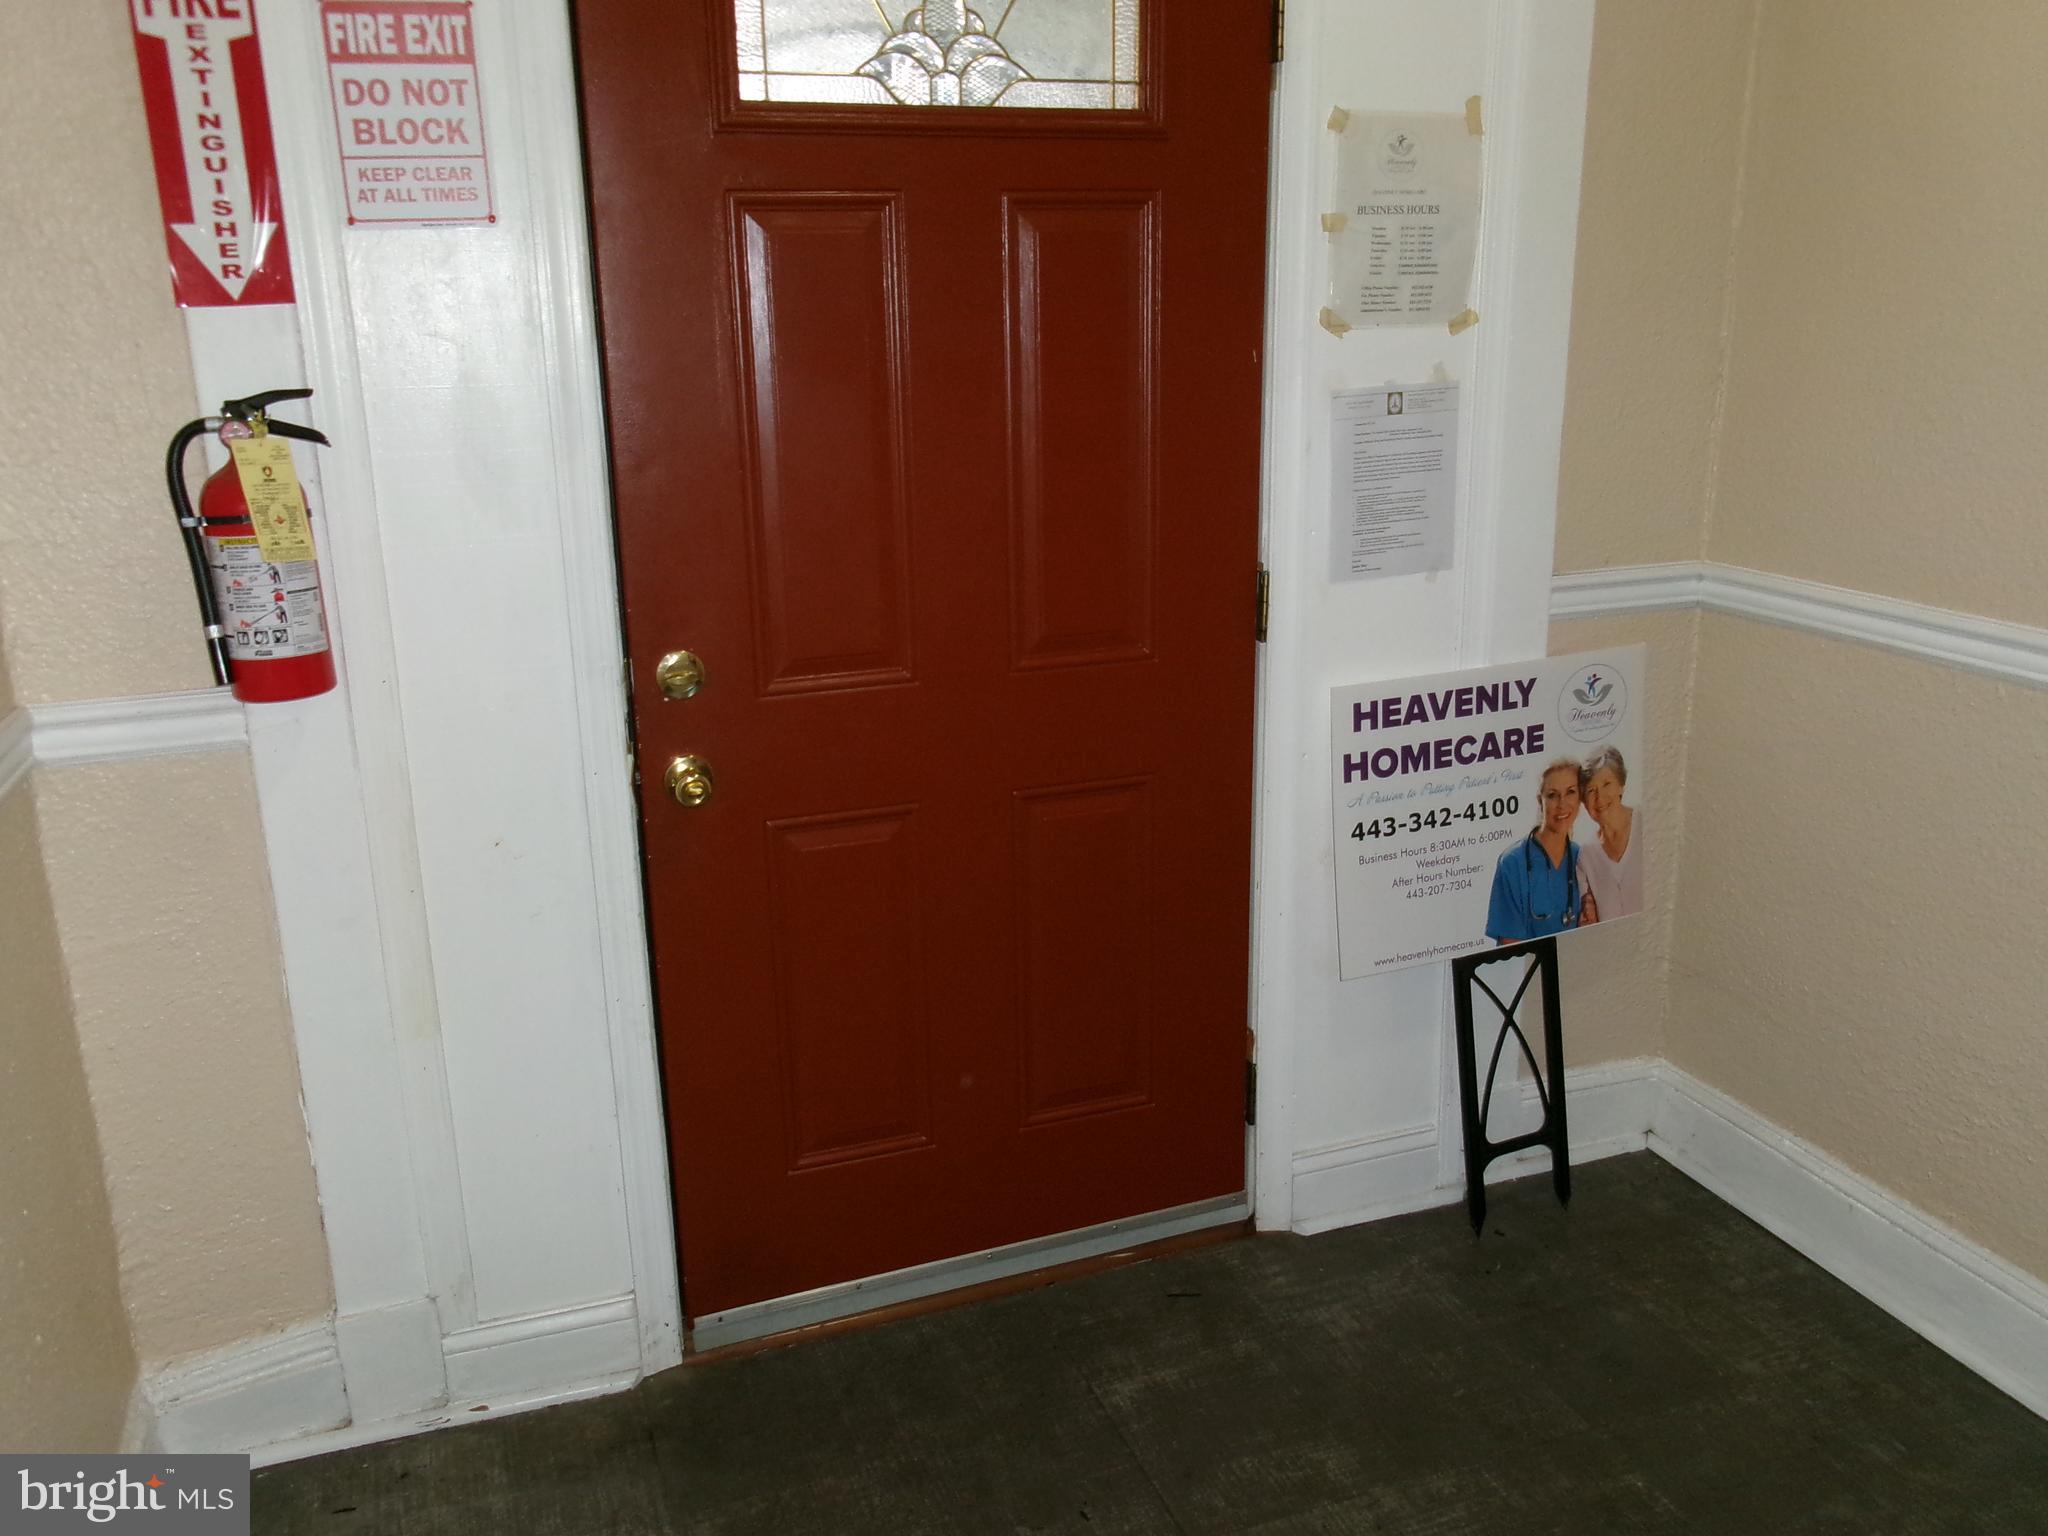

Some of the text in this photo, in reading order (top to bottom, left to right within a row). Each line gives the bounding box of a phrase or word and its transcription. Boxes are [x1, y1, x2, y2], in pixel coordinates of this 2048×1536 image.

[325, 12, 466, 55] FIRE EXIT
[342, 78, 468, 106] DO NOT
[352, 118, 469, 145] BLOCK
[185, 24, 245, 280] EXTINGUISHER
[358, 166, 473, 182] KEEP CLEAR
[357, 187, 479, 203] AT ALL TIMES
[1357, 204, 1440, 215] BUSINESS HOURS
[1353, 677, 1537, 732] HEAVENLY
[1570, 703, 1616, 722] Heavenly
[1343, 723, 1544, 783] HOMECARE
[1351, 795, 1519, 842] 443-342-4100
[1358, 828, 1513, 866] Business Hours 8:30AM to 6:00PM
[1416, 854, 1460, 869] Weekdays
[1391, 863, 1484, 889] After Hours Number:
[1406, 879, 1473, 899] 443-207-7304
[1374, 938, 1485, 967] www.heavenlyhomecare.us
